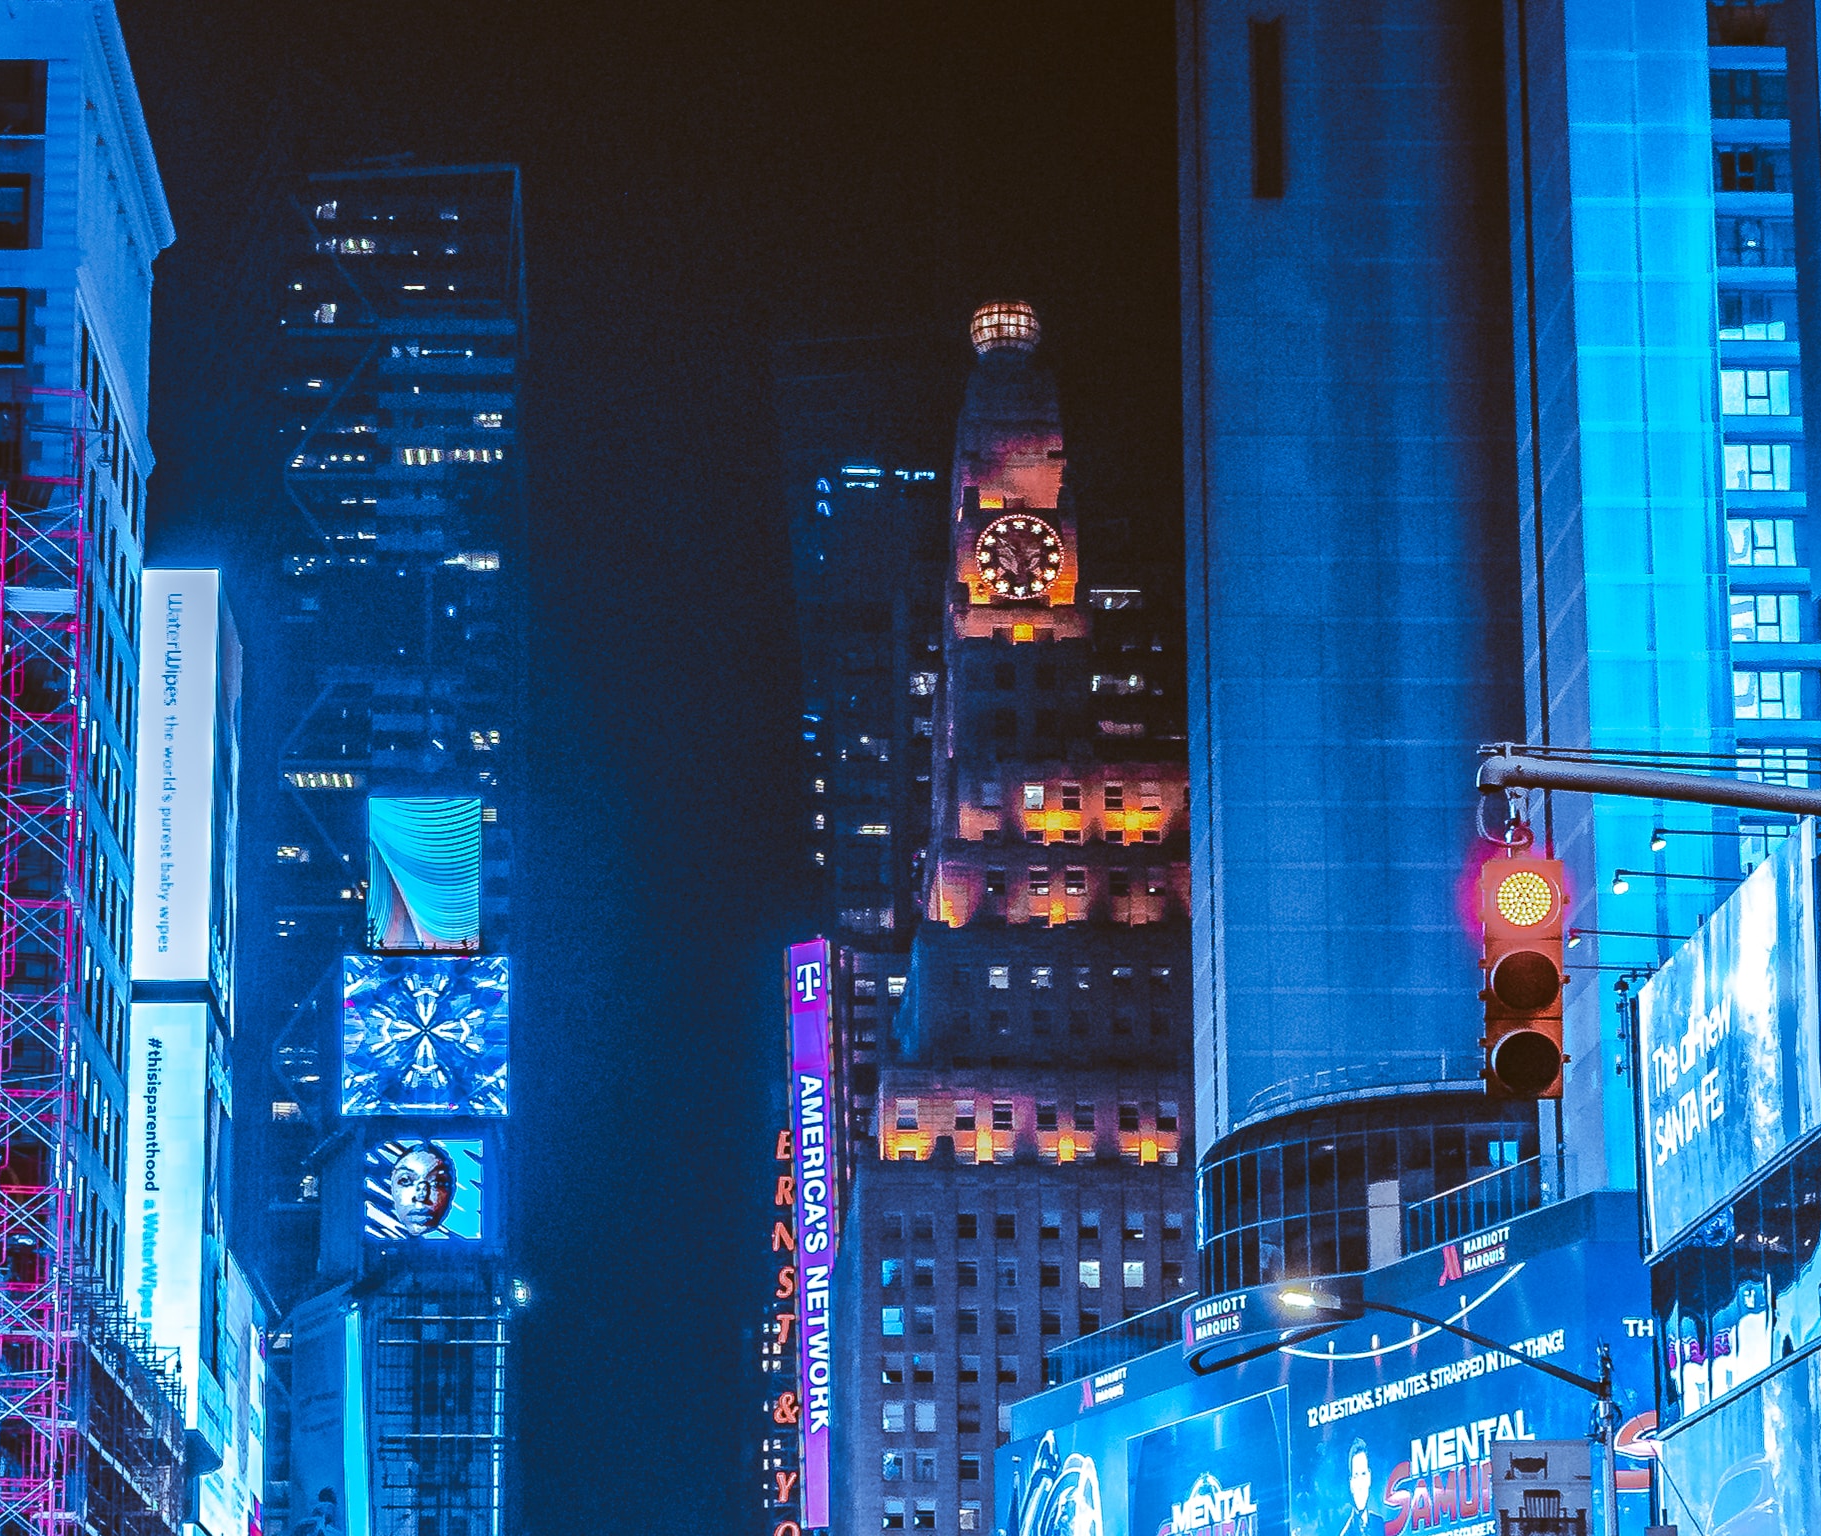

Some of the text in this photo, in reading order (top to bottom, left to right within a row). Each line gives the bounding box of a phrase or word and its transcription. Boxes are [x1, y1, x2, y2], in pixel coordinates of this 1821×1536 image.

[162, 593, 183, 707] WaterWipes
[1652, 1037, 1678, 1097] The
[143, 1037, 163, 1192] #thisisparenthood
[1654, 1066, 1724, 1167] SANTA FE
[798, 1075, 831, 1434] AMERICA'S NETWORK
[1462, 1226, 1511, 1254] MARRIOTT
[1463, 1246, 1506, 1274] MARQUIS
[771, 1129, 799, 1424] ERNST &
[1195, 1294, 1248, 1321] MARRIOTT
[1195, 1315, 1241, 1342] MARQUIS
[1430, 1358, 1485, 1392] STRAPPED
[1524, 1328, 1565, 1360] THING!
[1410, 1409, 1536, 1475] MENTAL
[1171, 1482, 1258, 1534] MENTAL
